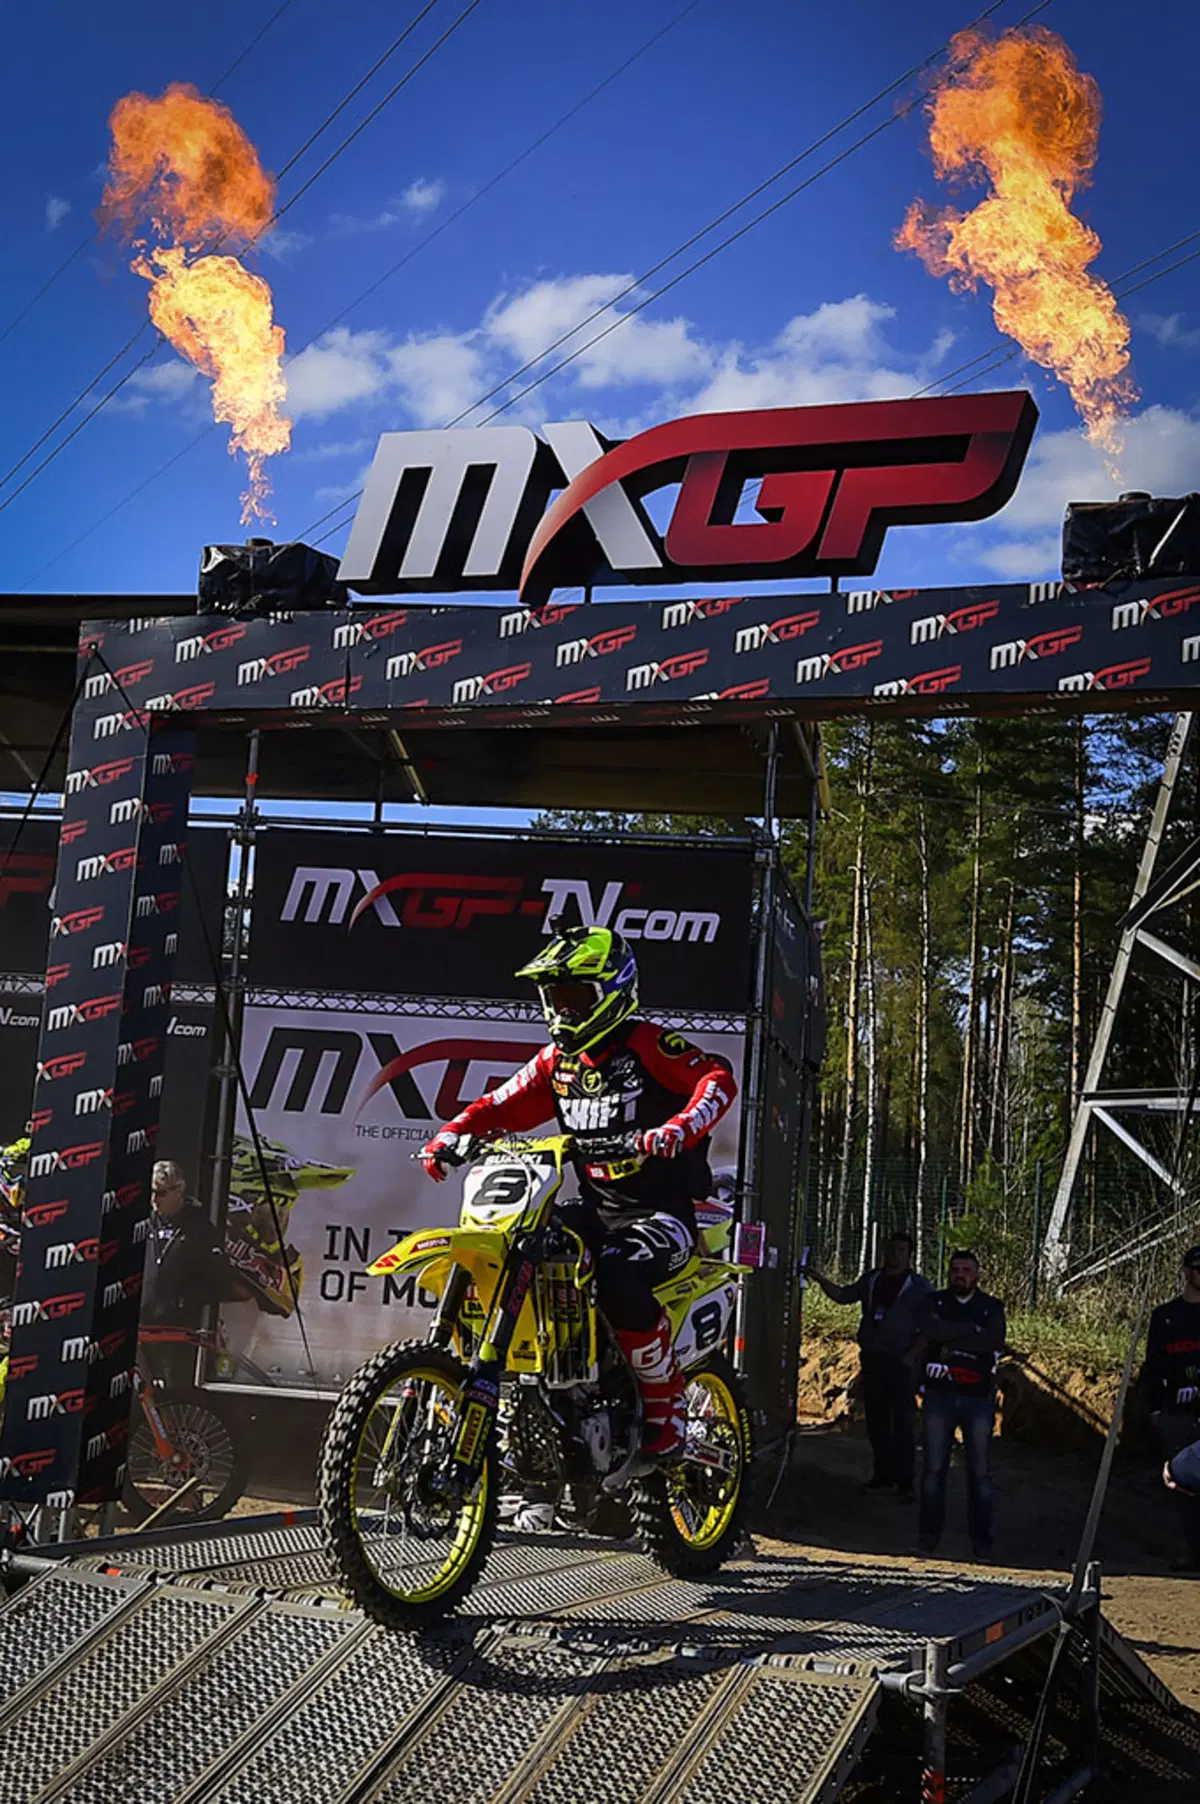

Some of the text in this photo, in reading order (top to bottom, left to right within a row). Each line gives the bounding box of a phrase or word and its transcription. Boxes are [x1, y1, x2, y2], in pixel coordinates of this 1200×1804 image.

[336, 390, 1034, 602] MXGP
[333, 609, 408, 650] MXGP
[500, 604, 579, 639] MXGP
[735, 609, 821, 654] MXGP
[911, 600, 1000, 645] MXGP
[174, 623, 248, 663] MXGP
[385, 640, 463, 681] MXGP
[556, 624, 638, 668] MXGP
[796, 640, 884, 684] MXGP
[990, 624, 1084, 670] MXGP
[84, 659, 154, 699] MXGP
[237, 644, 311, 686] MXGP
[452, 662, 532, 704] MXGP
[626, 648, 710, 692] MXGP
[873, 665, 962, 696] MXGP
[1058, 656, 1152, 691] MXGP
[145, 681, 216, 711] MXGP
[290, 674, 363, 707] MXGP
[66, 756, 135, 794] MXGP
[47, 992, 122, 1032] MXGP
[252, 1027, 556, 1124] MXG
[356, 1125, 379, 1139] THE
[29, 1141, 104, 1178] MXGP
[323, 1225, 371, 1263] IN
[320, 1269, 367, 1303] OF
[12, 1292, 86, 1327] MXGP
[691, 1301, 722, 1351] 8
